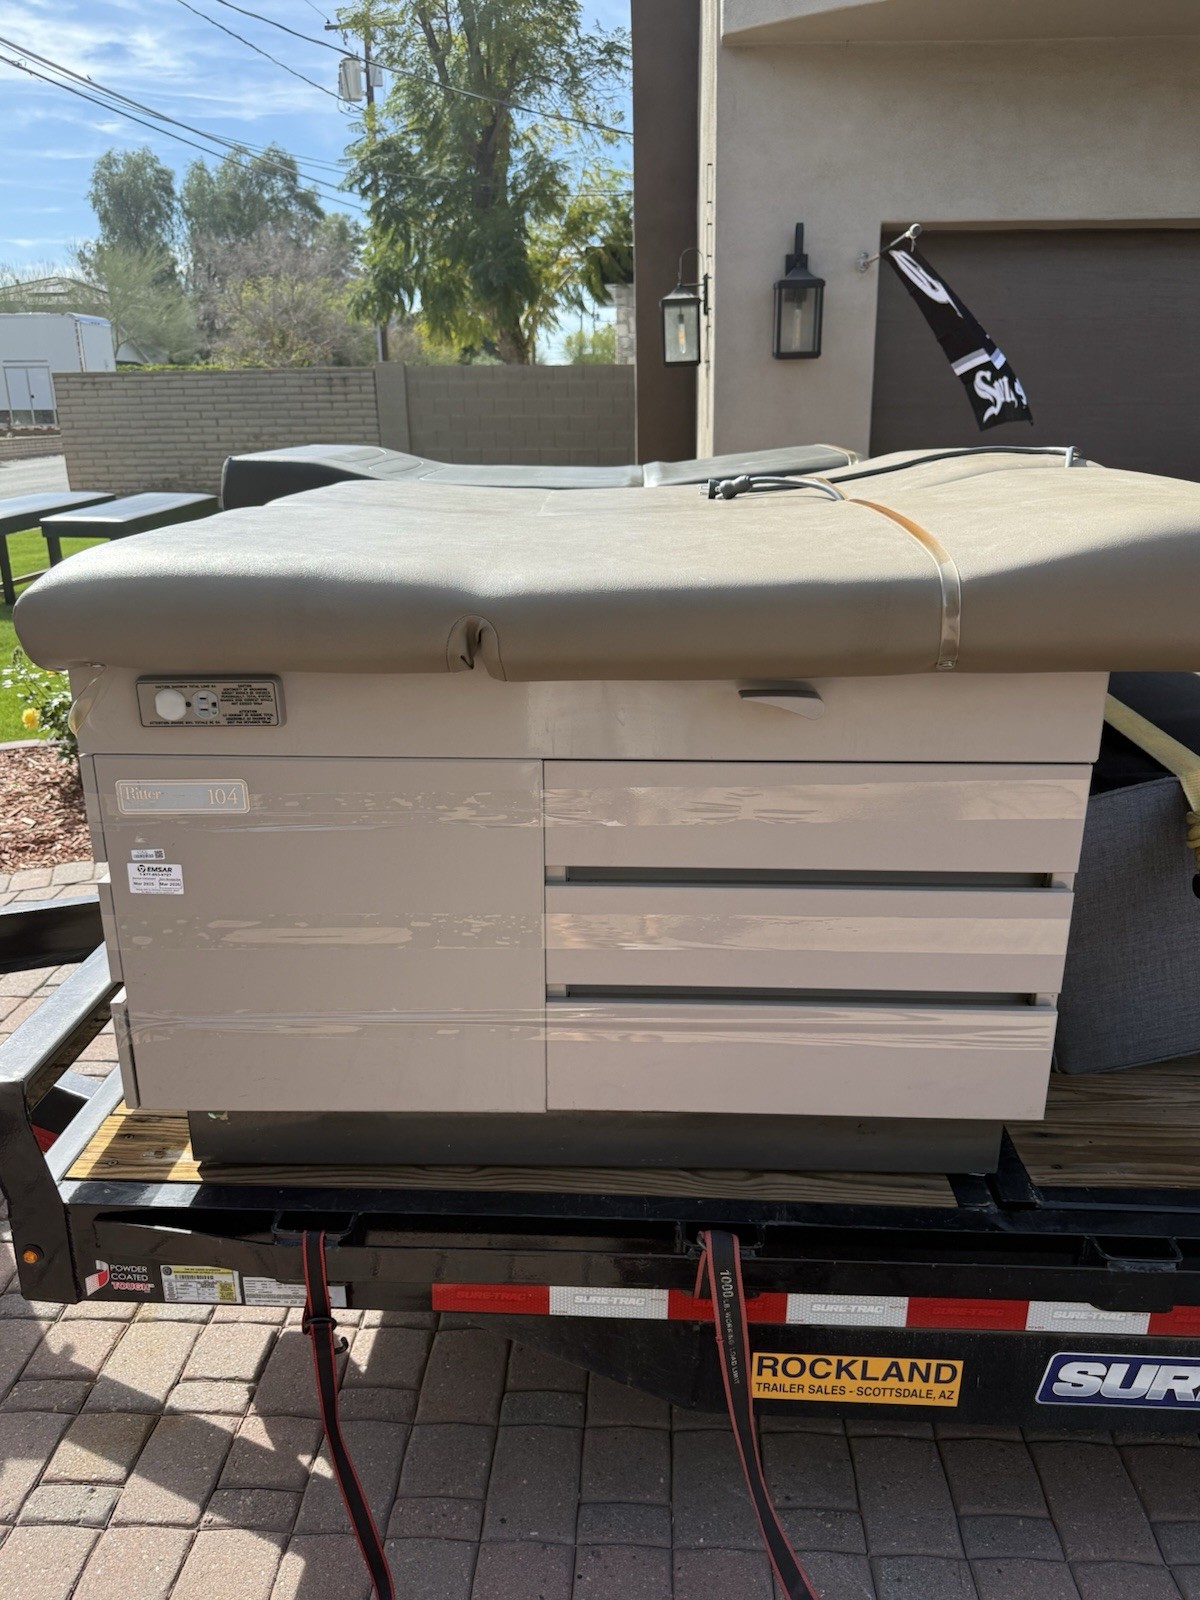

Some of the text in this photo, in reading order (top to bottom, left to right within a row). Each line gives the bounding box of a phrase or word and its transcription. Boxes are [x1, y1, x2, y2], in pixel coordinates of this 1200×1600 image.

[124, 786, 238, 805] Ritter 104
[110, 1264, 148, 1273] POWDER
[110, 1272, 148, 1282] COATED
[111, 1282, 150, 1291] TOUGH
[720, 1270, 734, 1299] 1000
[574, 1295, 646, 1306] SURE-TRAC
[811, 1304, 885, 1314] SURE-TRAC
[1052, 1310, 1126, 1321] SURE-TRAC
[756, 1356, 959, 1384] ROCKLAND
[1052, 1361, 1200, 1402] SUR
[756, 1382, 805, 1395] TRAILER
[808, 1384, 848, 1396] SALES
[856, 1386, 938, 1400] SCOTTSDALE,
[938, 1388, 955, 1400] AZ
